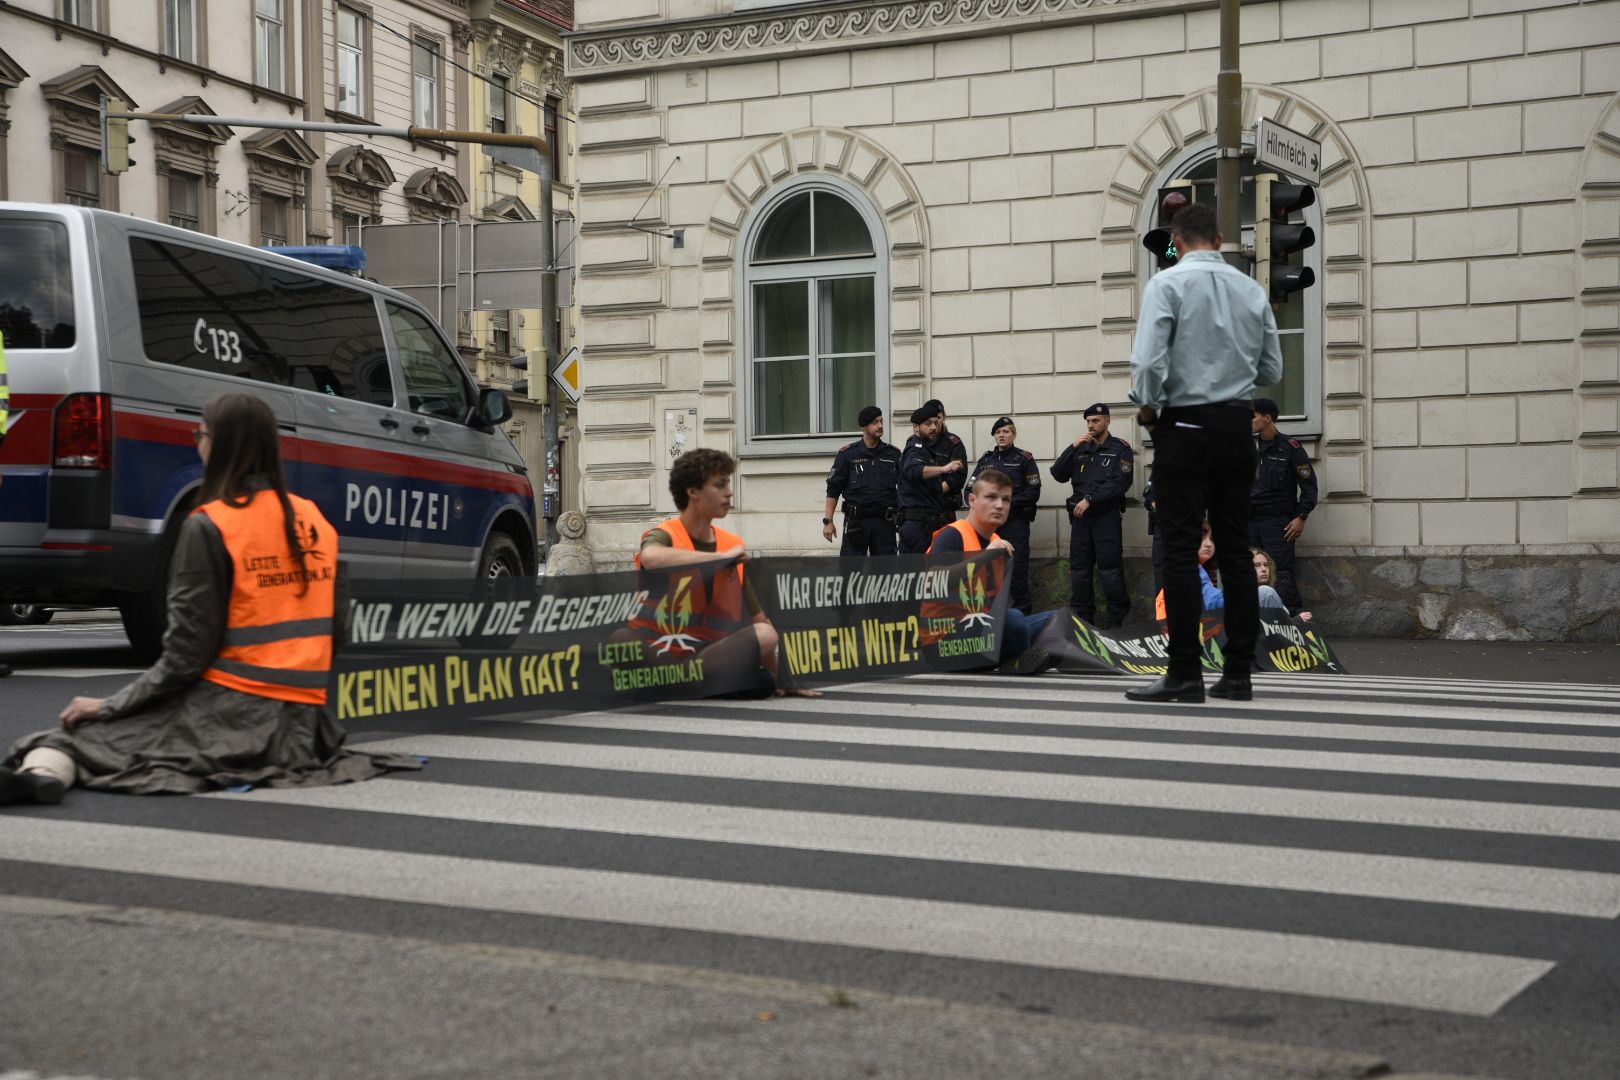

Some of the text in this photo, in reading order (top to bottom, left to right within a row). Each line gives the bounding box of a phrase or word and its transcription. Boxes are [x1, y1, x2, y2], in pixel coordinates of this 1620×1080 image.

[1266, 130, 1307, 169] Hilmteich
[207, 327, 243, 364] 133
[345, 482, 449, 531] POLIZEI
[776, 569, 950, 611] WAR DER KLIMARAT DENN
[349, 590, 650, 643] ND WENN DIE REGIERUNG
[928, 617, 957, 637] LETZTE
[597, 640, 644, 666] LETZTE
[783, 615, 920, 676] NUR EIN WITZ?
[938, 633, 996, 657] GENERATION.AT
[336, 644, 581, 720] KEINEN PLAN HAT?
[612, 659, 704, 692] GENERATION.AT
